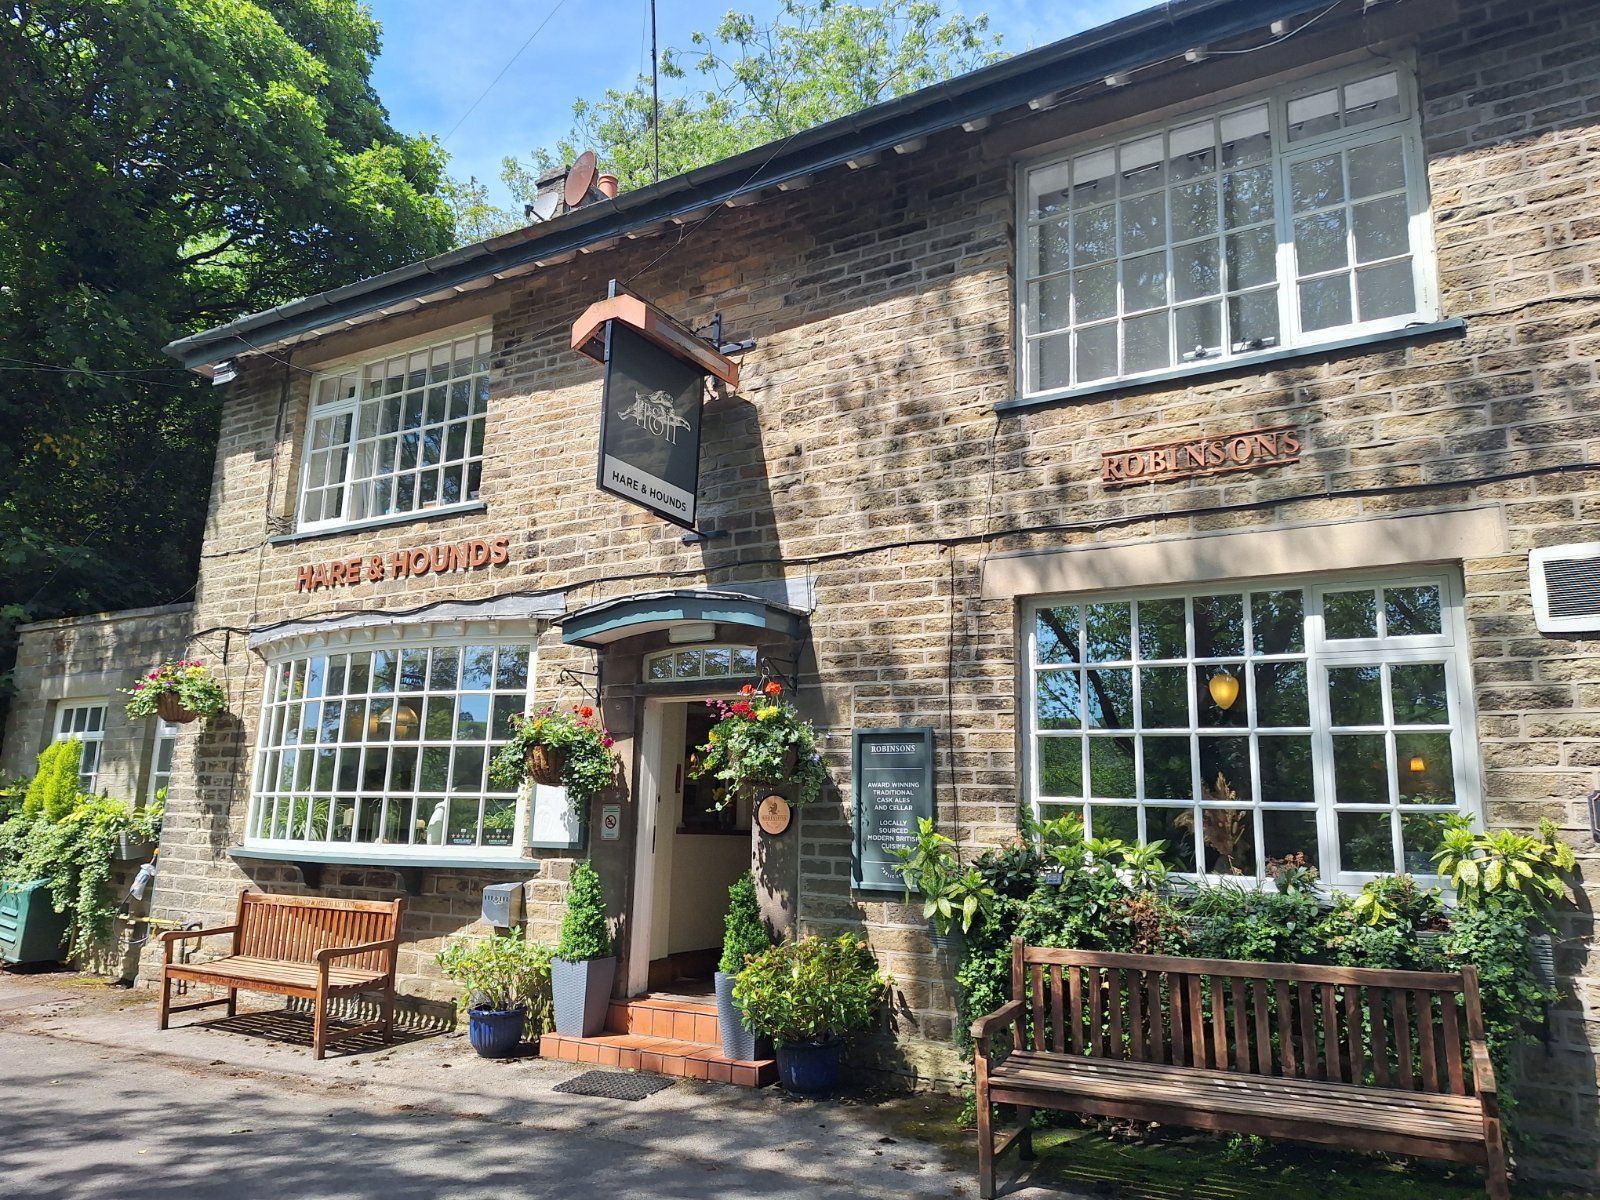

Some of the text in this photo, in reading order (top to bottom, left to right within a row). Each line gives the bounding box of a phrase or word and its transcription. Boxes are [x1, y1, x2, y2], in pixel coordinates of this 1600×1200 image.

[1102, 430, 1300, 482] ROBINSONS
[612, 470, 687, 512] HARE & HOUNDS
[295, 537, 510, 593] HARE & HOUNDS
[871, 744, 916, 753] ROBINSONS
